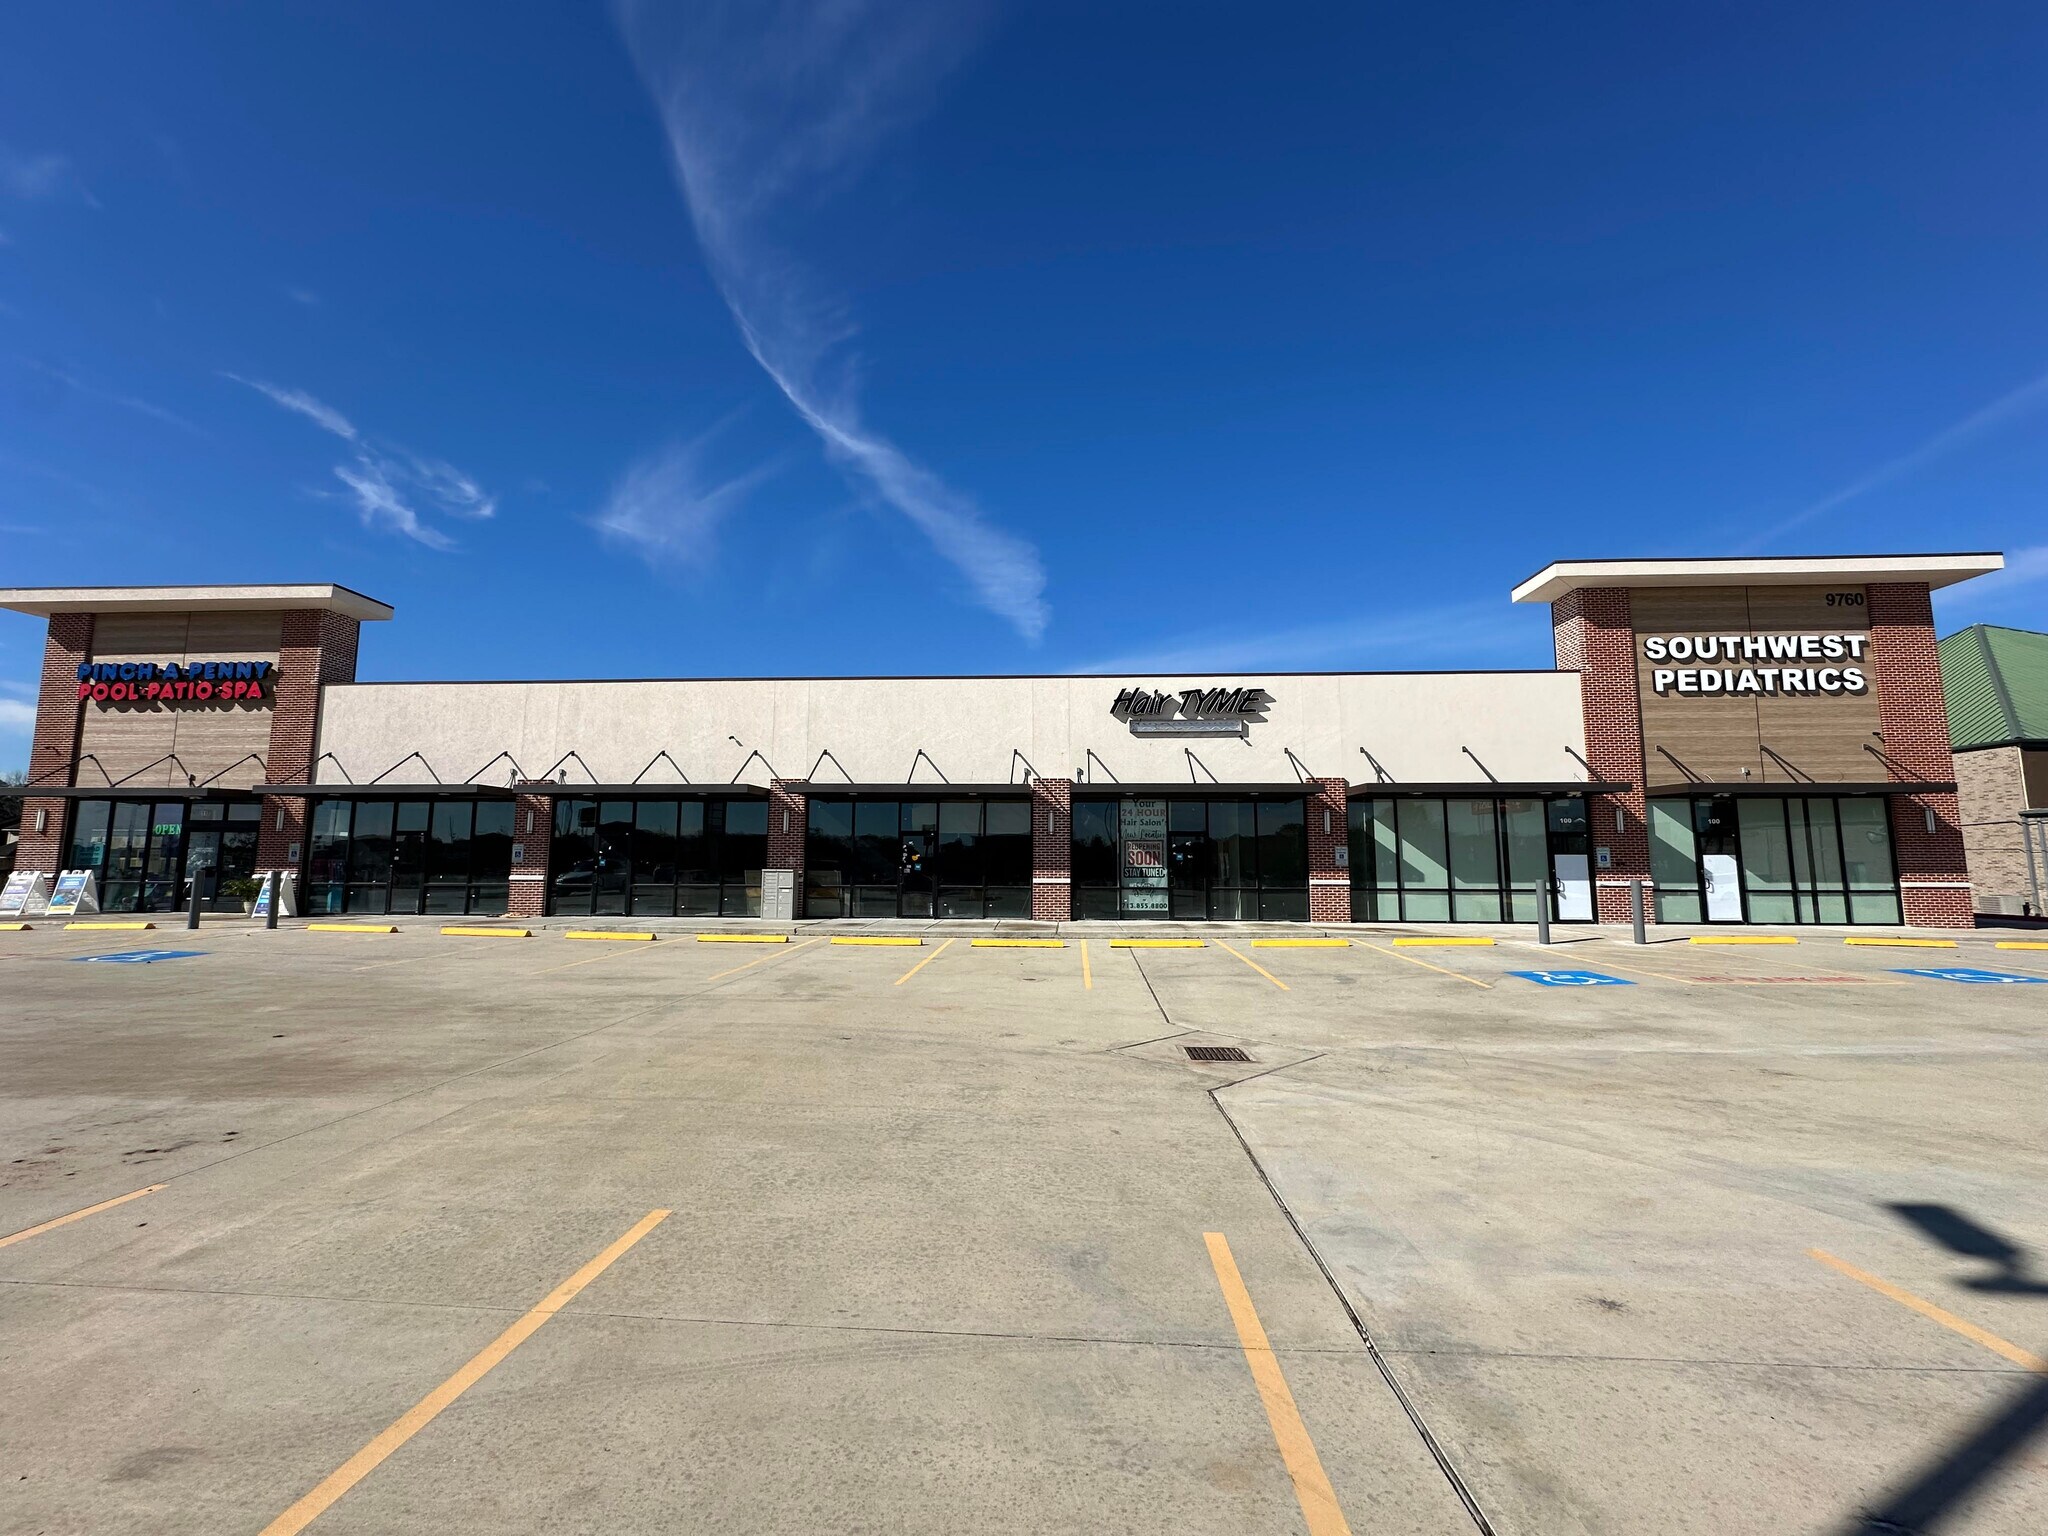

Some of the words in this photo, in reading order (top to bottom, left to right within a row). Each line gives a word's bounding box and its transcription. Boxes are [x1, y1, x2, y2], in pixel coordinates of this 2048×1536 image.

[1826, 593, 1864, 606] 9760
[1645, 634, 1866, 660] SOUTHWEST
[78, 663, 153, 681] PINCH
[189, 661, 272, 680] PENNY
[1654, 667, 1865, 692] PEDIATRICS
[79, 682, 139, 701] POOL
[149, 681, 213, 700] PATIO
[220, 681, 263, 699] SPA
[1110, 687, 1172, 715] Hair
[1179, 687, 1266, 715] TYME
[1132, 799, 1156, 808] Your
[1121, 809, 1133, 817] 24
[1137, 809, 1166, 817] HOUR
[1120, 818, 1137, 826] Hair
[155, 824, 182, 835] OPEN
[1128, 851, 1161, 866] SOON
[1124, 868, 1140, 877] STAY
[1141, 868, 1164, 877] TUNED
